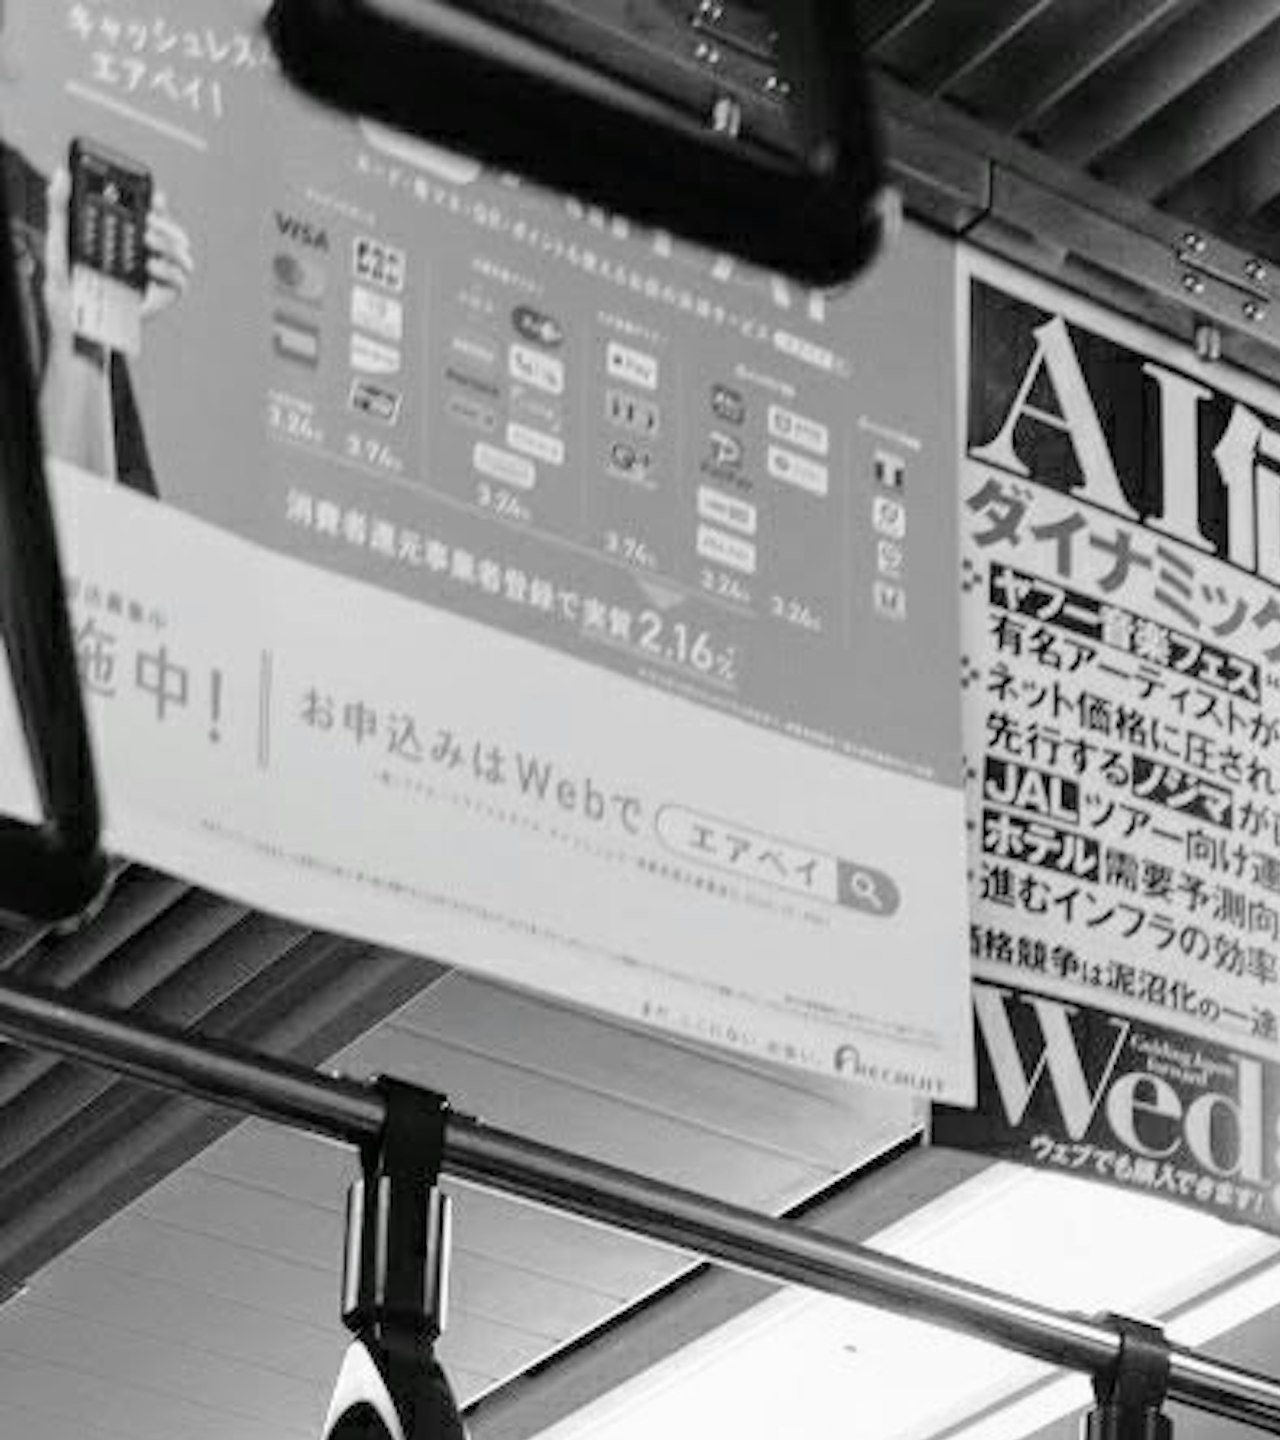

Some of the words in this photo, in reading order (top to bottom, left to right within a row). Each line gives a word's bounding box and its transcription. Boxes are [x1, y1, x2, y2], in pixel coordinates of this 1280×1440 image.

[274, 211, 330, 251] VISA
[689, 823, 817, 887] エアペイ
